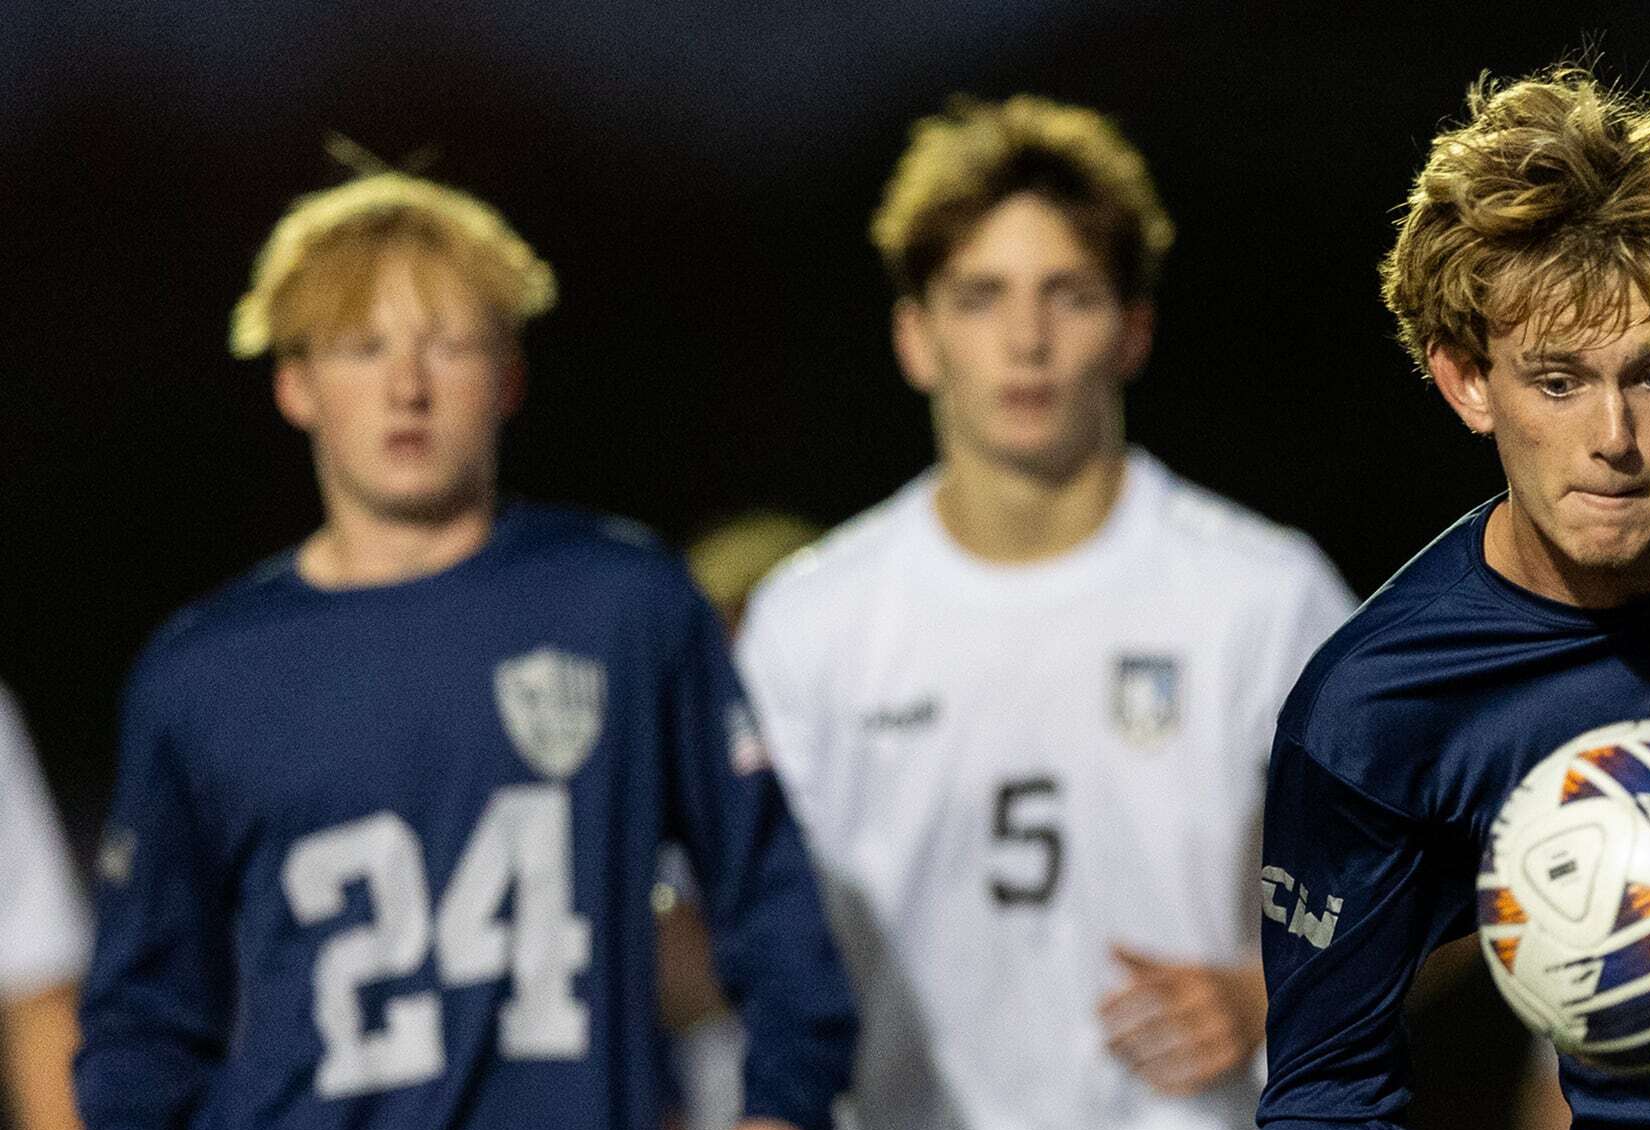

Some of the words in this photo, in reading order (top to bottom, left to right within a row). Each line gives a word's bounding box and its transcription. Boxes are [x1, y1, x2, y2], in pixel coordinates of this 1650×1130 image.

[991, 774, 1066, 908] 5
[1261, 865, 1344, 950] CW
[282, 785, 592, 1098] 24
